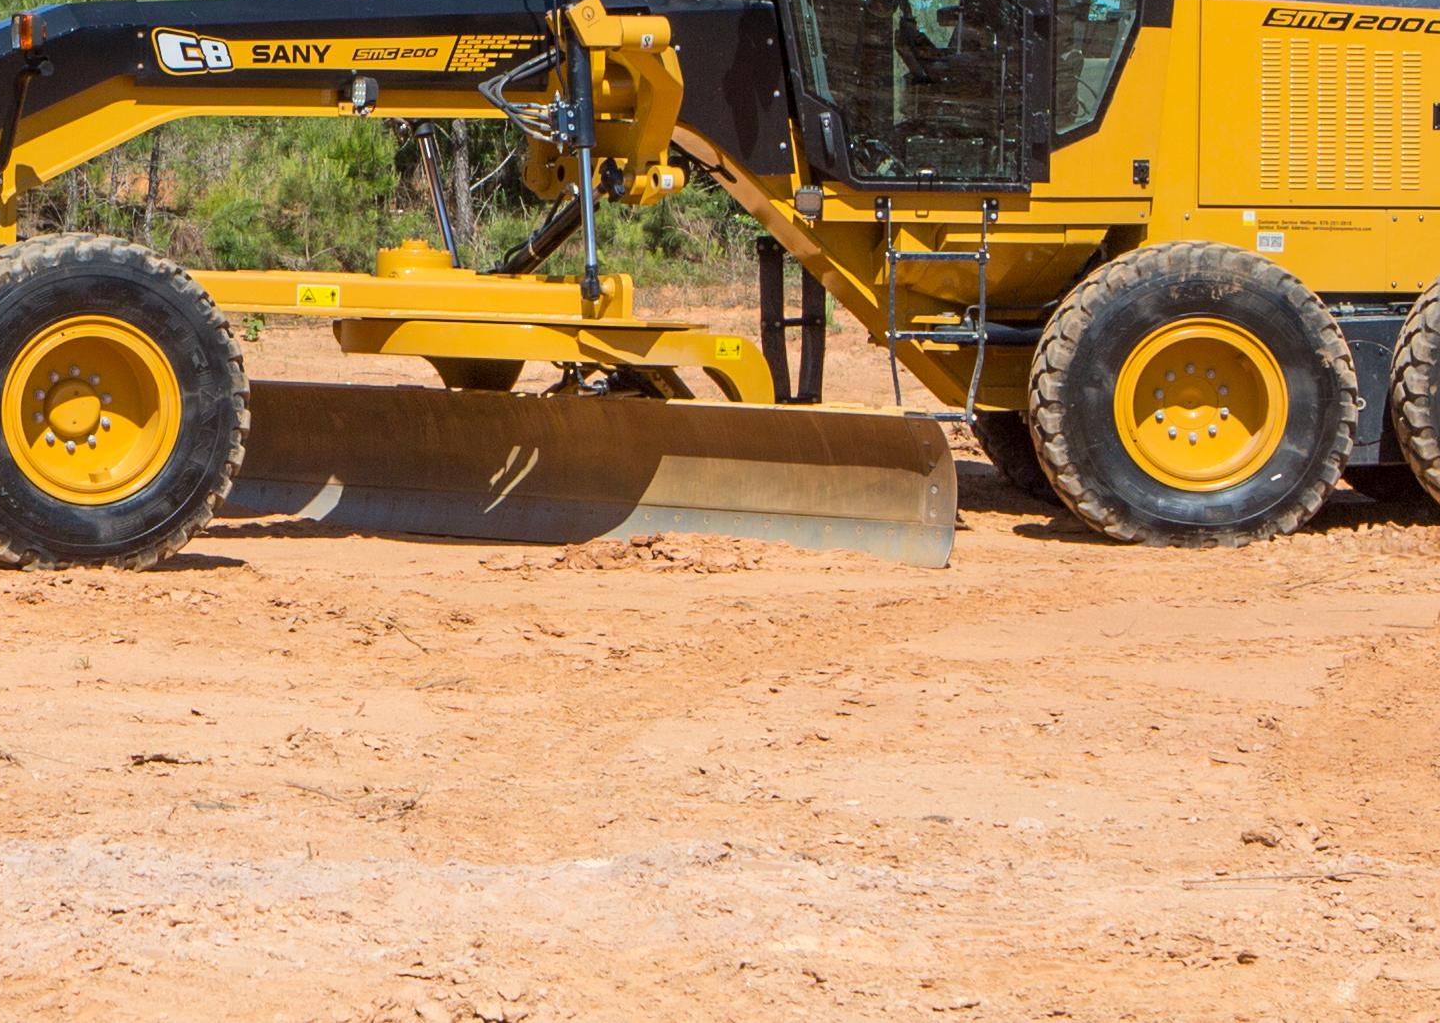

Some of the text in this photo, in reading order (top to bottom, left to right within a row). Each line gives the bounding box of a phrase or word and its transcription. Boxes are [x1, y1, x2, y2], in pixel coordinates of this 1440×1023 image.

[1265, 8, 1351, 31] SMG
[251, 44, 332, 64] SANY
[353, 47, 399, 61] SMG
[400, 47, 439, 60] 200
